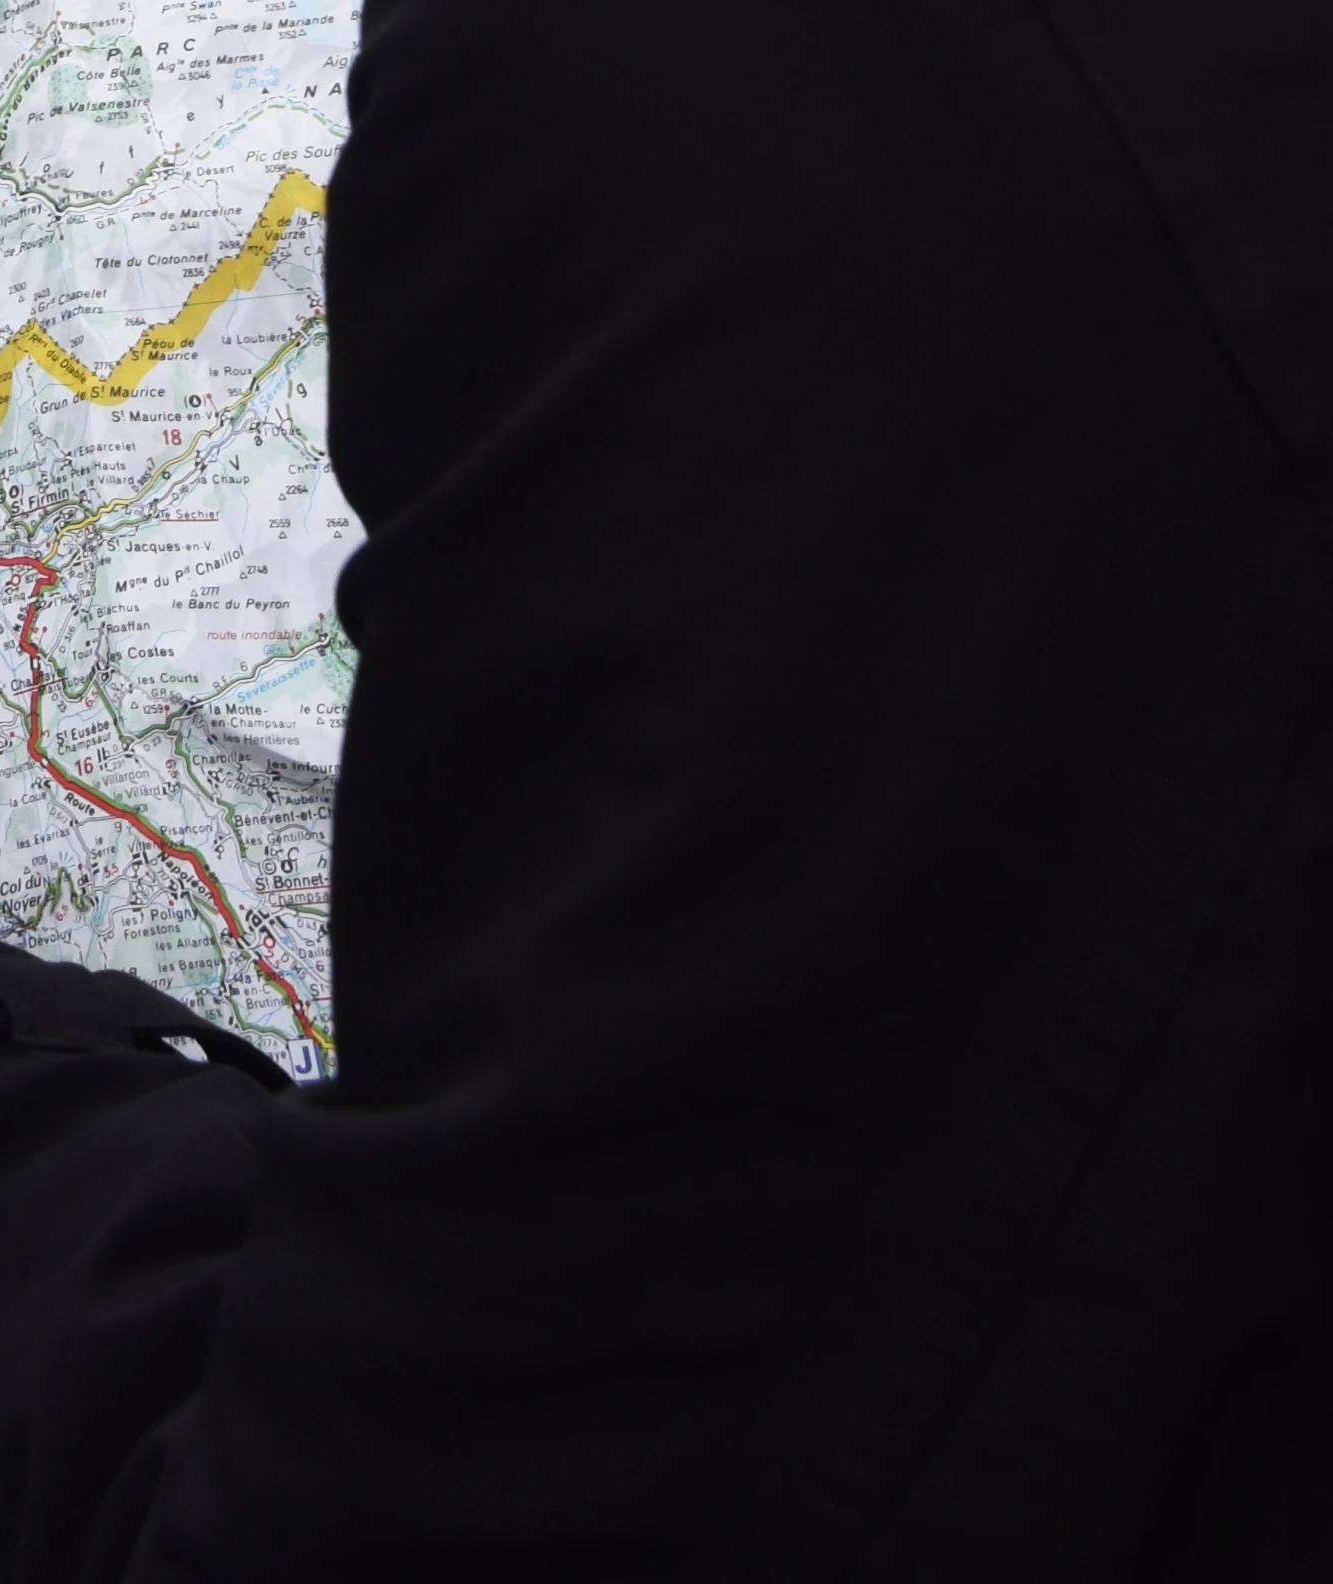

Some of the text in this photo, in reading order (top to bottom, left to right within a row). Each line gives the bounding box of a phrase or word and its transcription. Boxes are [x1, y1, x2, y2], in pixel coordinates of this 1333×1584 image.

[27, 96, 149, 124] Pic Valsenestre
[180, 206, 242, 219] Marceline
[95, 253, 208, 270] Tête du Clotonnet
[40, 399, 68, 414] Grun
[110, 386, 165, 398] Maurice
[163, 430, 182, 445] 18
[29, 488, 69, 509] Firmin
[128, 646, 175, 660] Costes
[74, 757, 93, 776] 16
[294, 1046, 314, 1075] J
